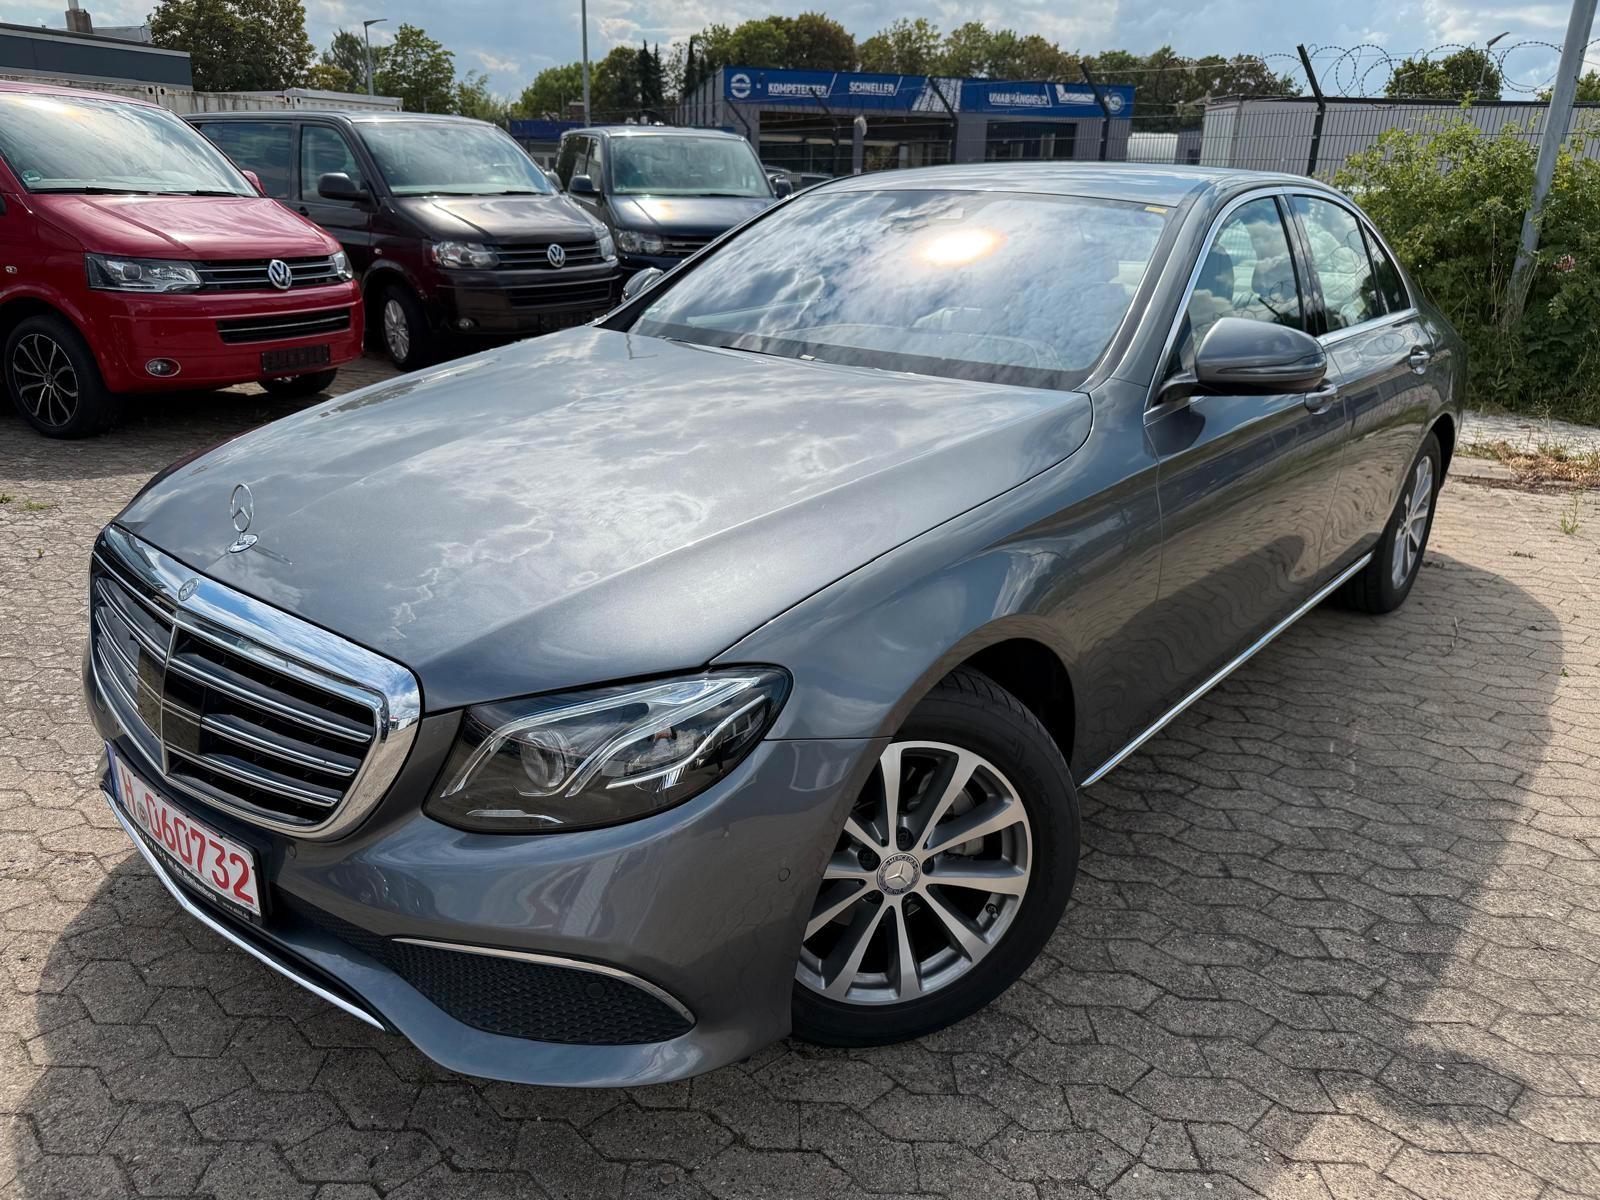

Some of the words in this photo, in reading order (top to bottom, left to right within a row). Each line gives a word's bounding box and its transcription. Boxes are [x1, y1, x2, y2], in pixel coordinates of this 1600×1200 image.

[849, 81, 895, 93] SCHNELLER
[120, 766, 137, 817] H
[145, 793, 254, 904] 060732
